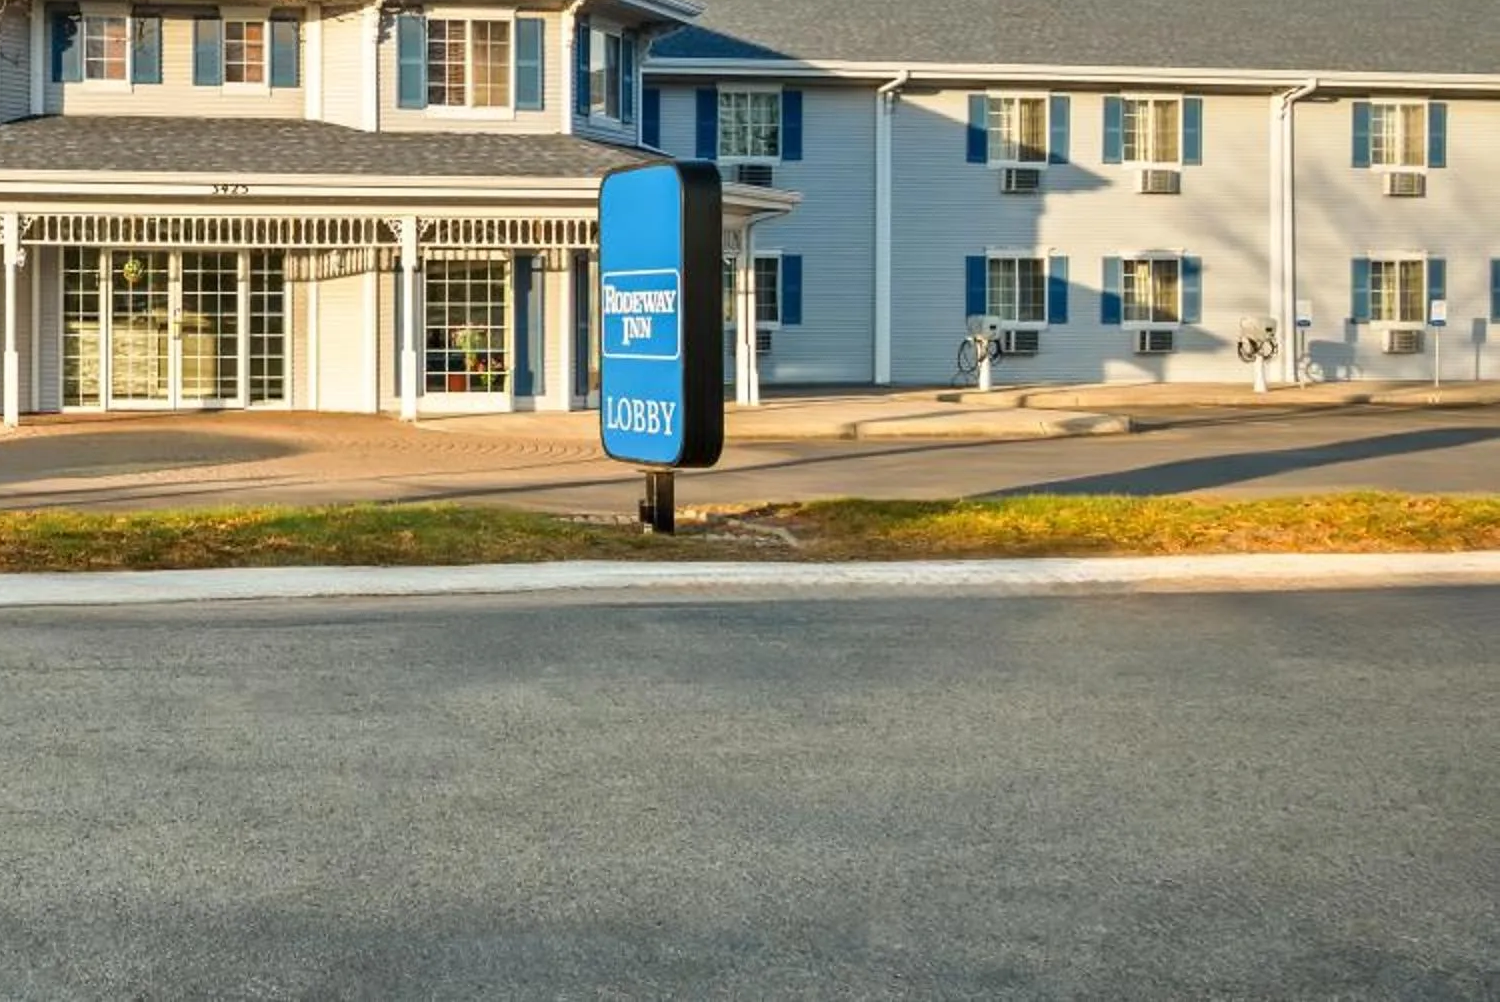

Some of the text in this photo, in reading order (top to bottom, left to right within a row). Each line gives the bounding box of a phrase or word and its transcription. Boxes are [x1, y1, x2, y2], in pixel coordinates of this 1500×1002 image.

[603, 285, 676, 314] RODEWAY
[622, 317, 652, 346] INN
[607, 396, 676, 436] LOBBY
